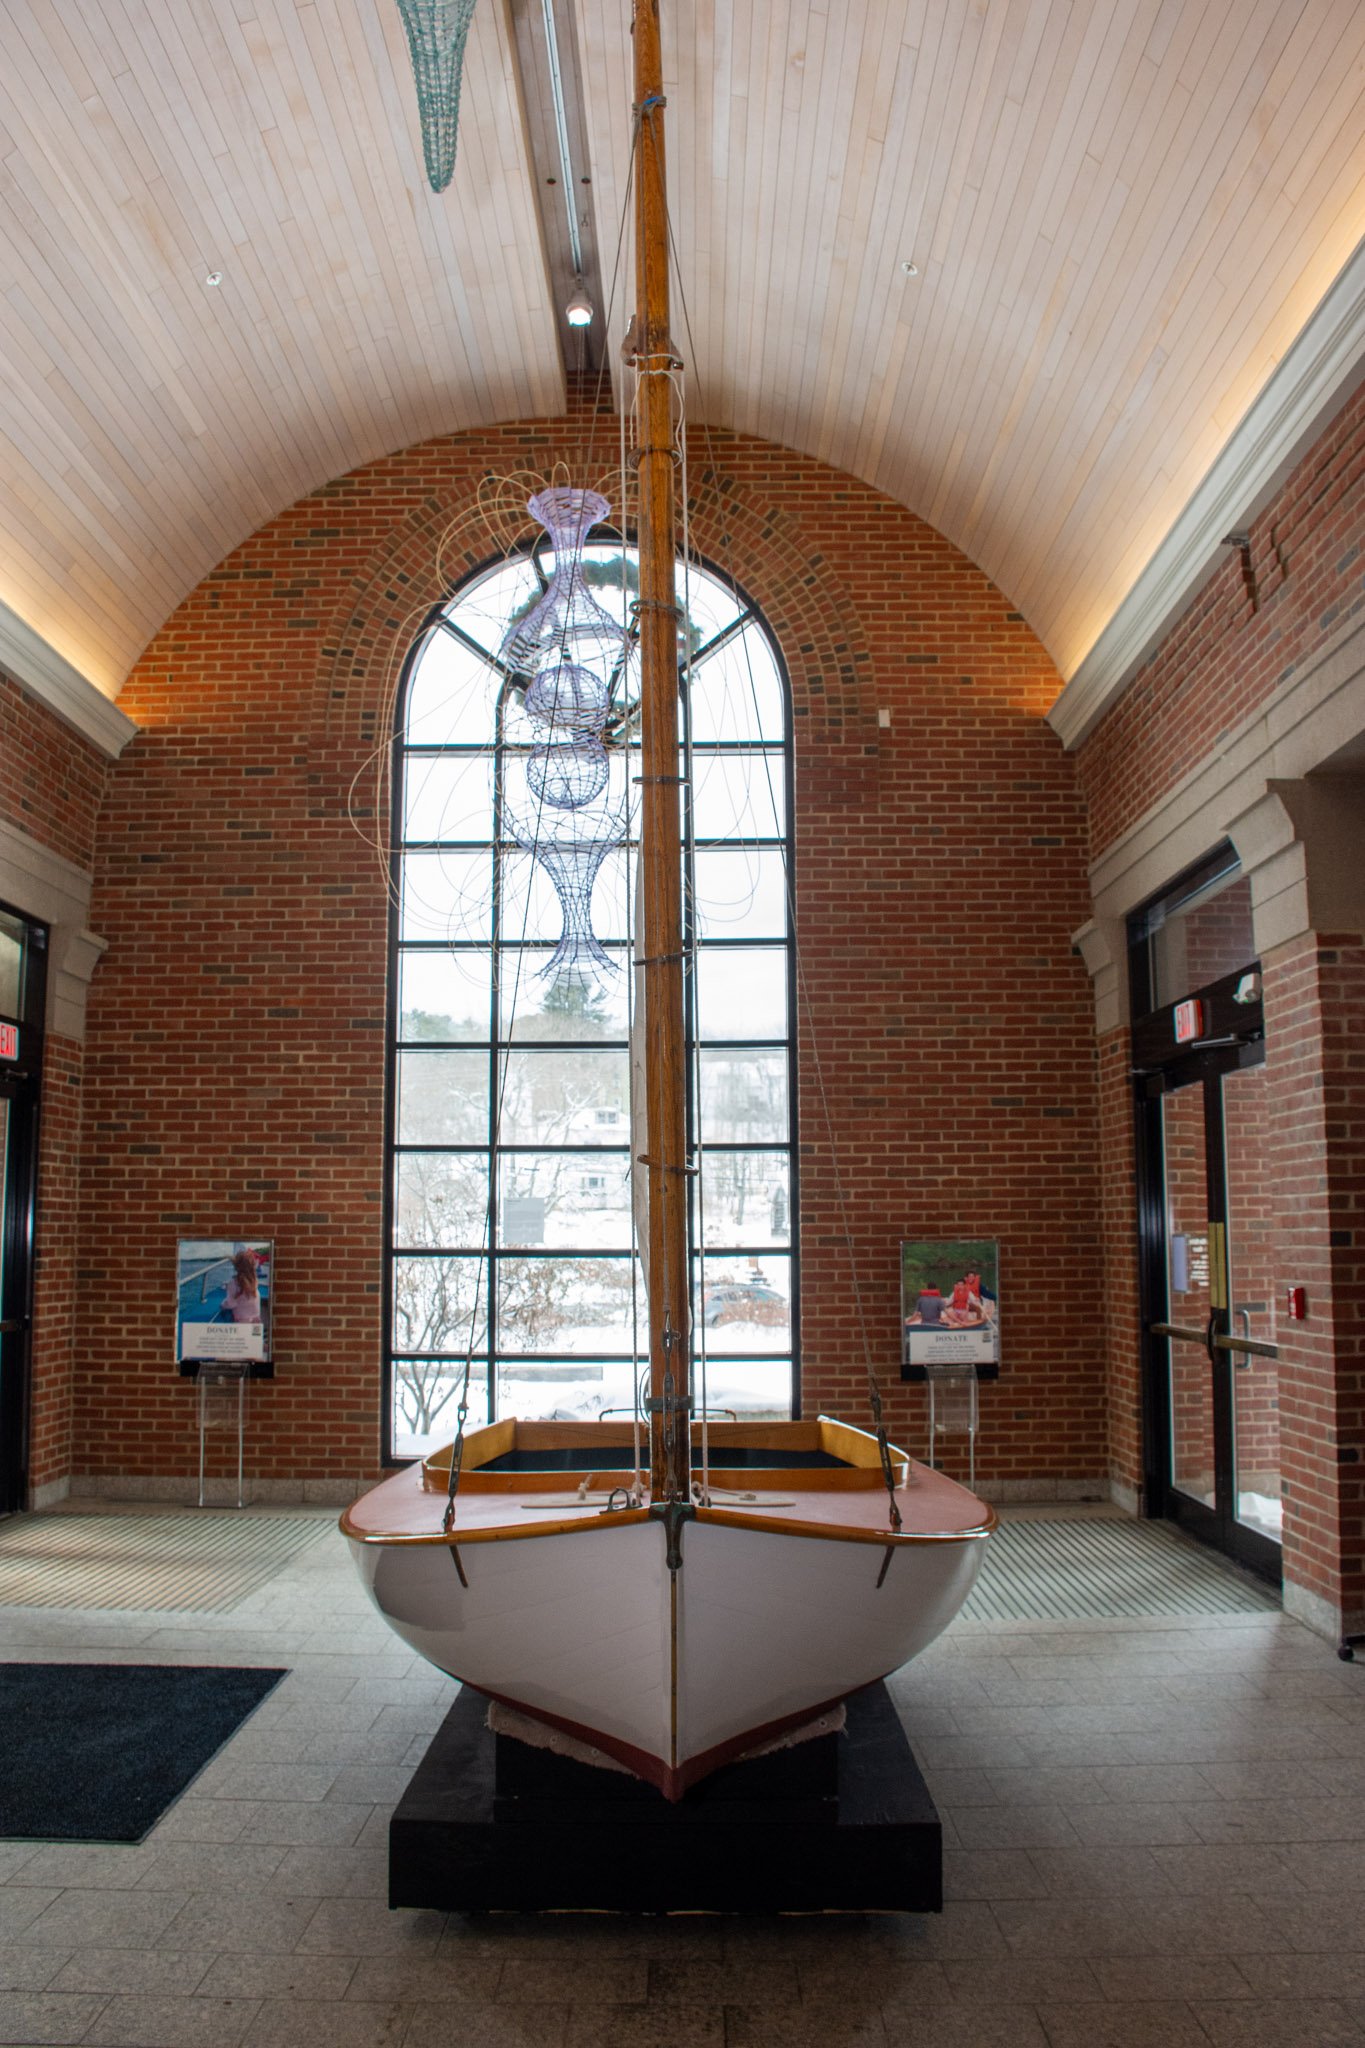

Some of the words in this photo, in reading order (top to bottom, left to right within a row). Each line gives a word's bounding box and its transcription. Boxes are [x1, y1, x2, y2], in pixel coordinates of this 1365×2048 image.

[1177, 1003, 1190, 1039] EXIT
[0, 1024, 16, 1056] EXIT
[935, 1335, 968, 1343] DONATE
